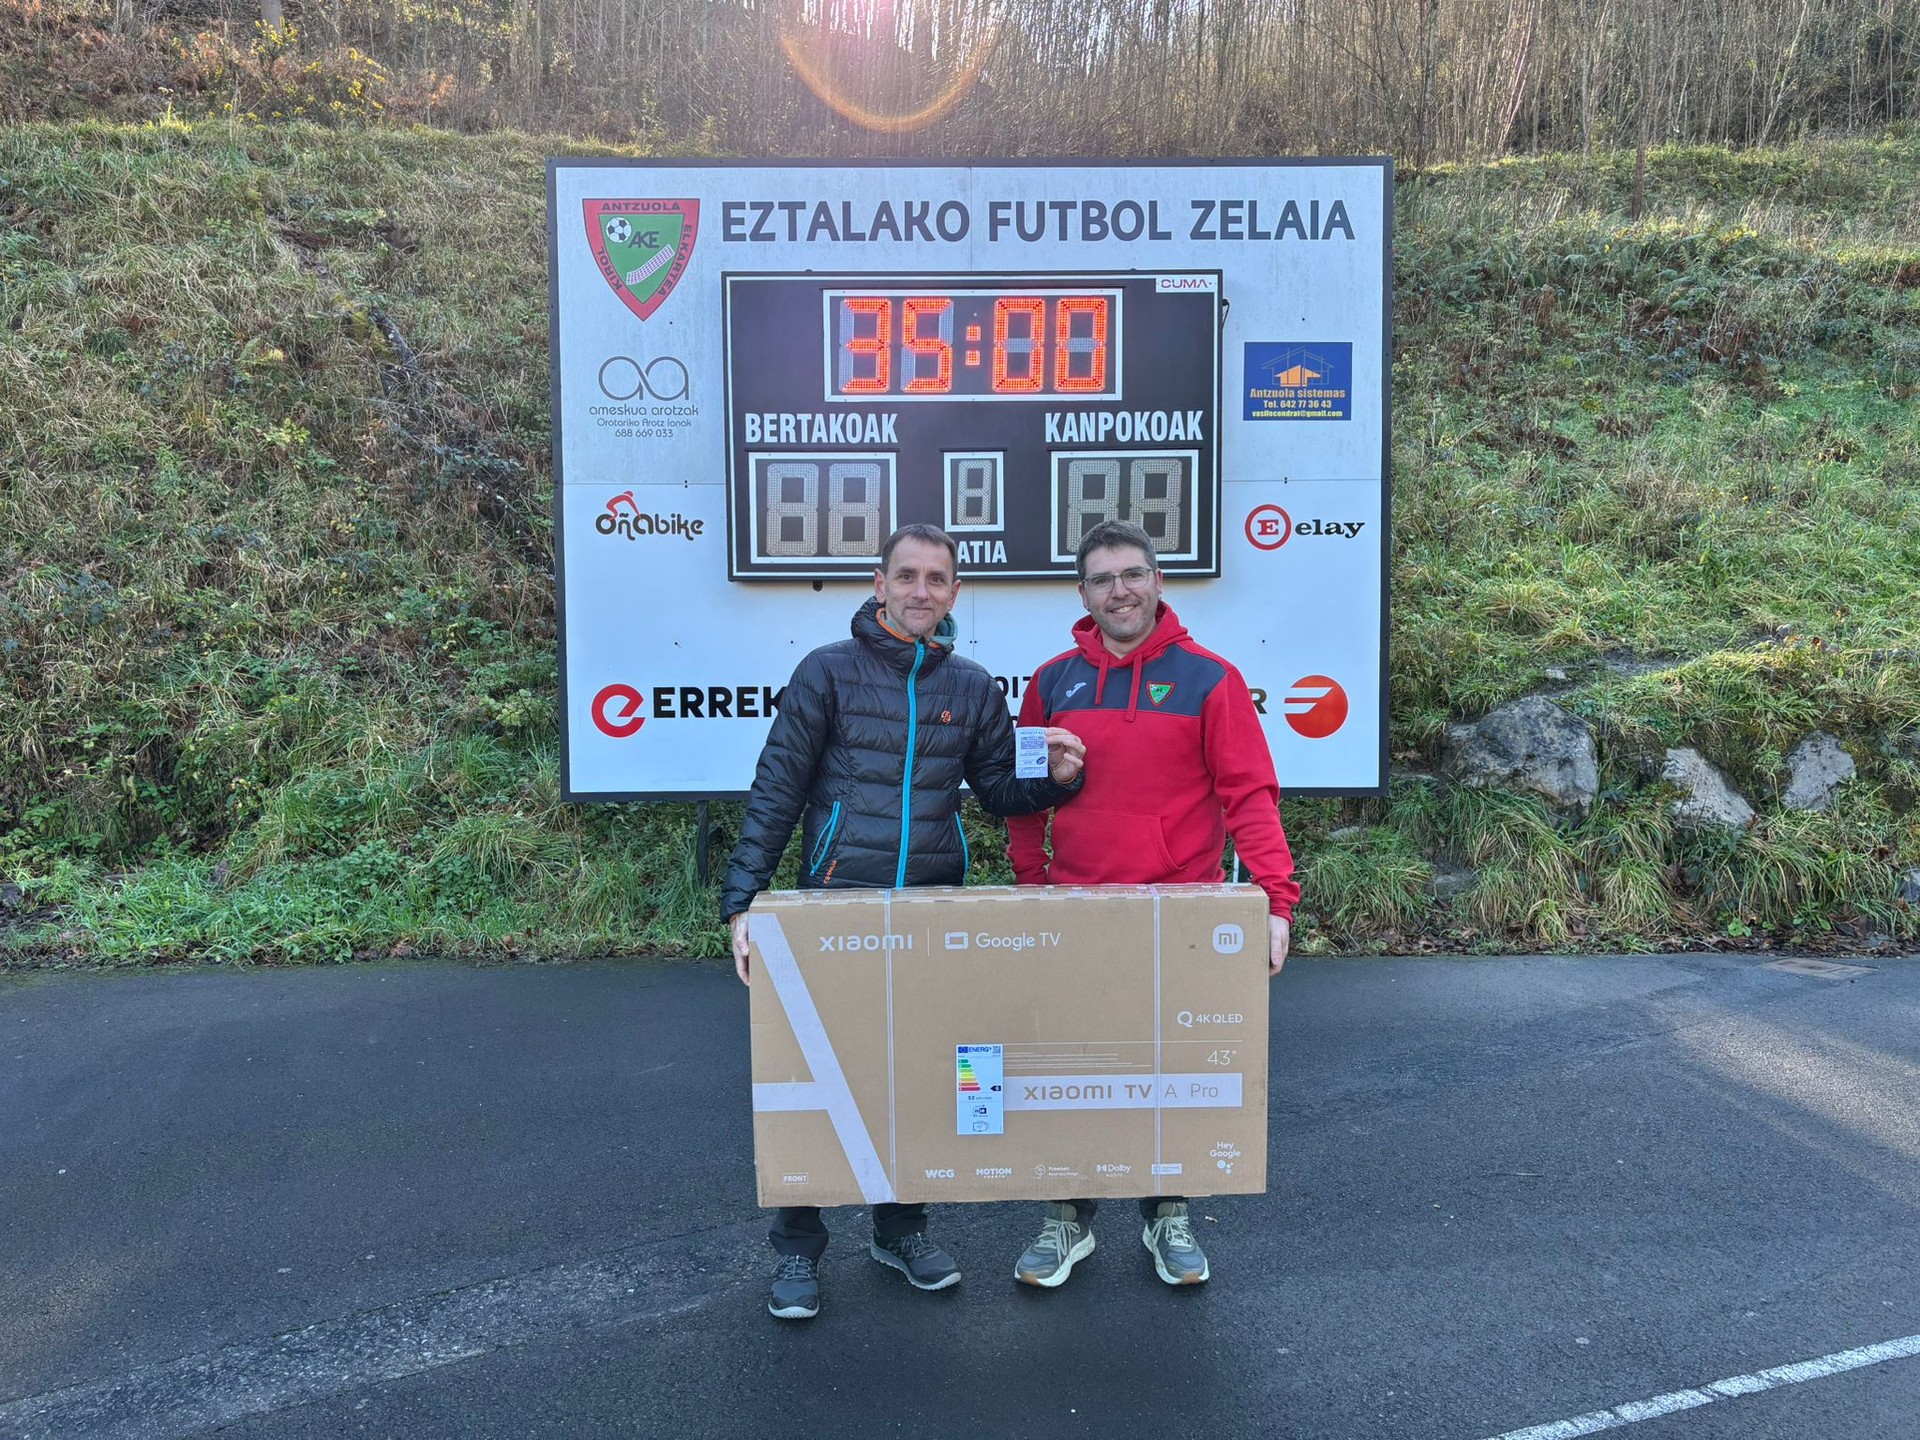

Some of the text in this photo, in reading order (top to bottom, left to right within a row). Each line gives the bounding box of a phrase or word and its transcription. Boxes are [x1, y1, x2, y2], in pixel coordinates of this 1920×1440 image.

[602, 203, 681, 211] ANTZUOLA
[722, 200, 1356, 242] EZTALAKO FUTBOL ZELAIA
[657, 224, 692, 296] ELKARTEA
[598, 246, 623, 290] KIROL
[1161, 279, 1208, 288] CUMA
[841, 297, 1108, 393] 35:00
[1250, 388, 1346, 398] Antzuola sistemas
[1264, 400, 1332, 408] Tel. 642 77 36 43
[589, 404, 699, 416] ameskua arotzak
[597, 418, 640, 427] Orotariko
[642, 418, 665, 427] Arotz
[1044, 410, 1204, 442] KANPOKOAK
[615, 429, 674, 438] 688 669 033
[745, 413, 898, 444] BERTAKOAK
[1295, 518, 1365, 539] elay
[957, 541, 1007, 563] ATIA
[976, 932, 1035, 950] Google
[1039, 933, 1061, 946] TV
[1196, 1014, 1211, 1024] 4K
[1213, 1014, 1243, 1024] QLED
[1125, 1084, 1152, 1099] TV
[1165, 1084, 1177, 1098] A
[1190, 1083, 1219, 1097] Pro
[1217, 1142, 1233, 1151] Hey
[1210, 1149, 1241, 1159] Google
[925, 1169, 955, 1178] WCG
[976, 1168, 1012, 1176] MOTION
[1108, 1164, 1131, 1173] Dolby
[783, 1175, 807, 1183] FRONT
